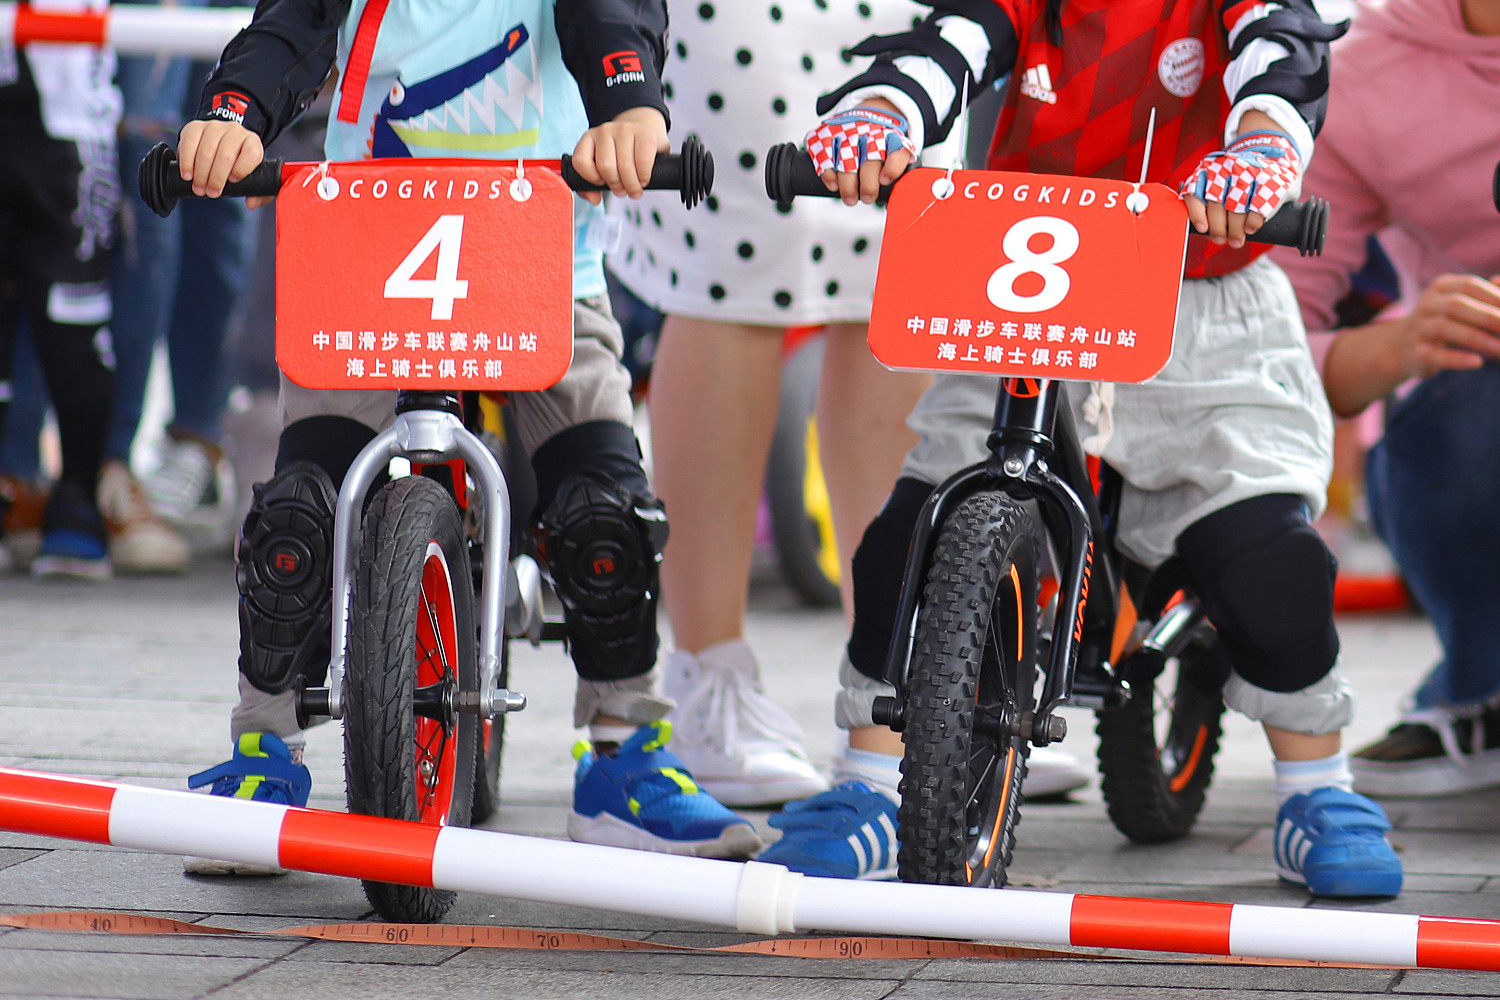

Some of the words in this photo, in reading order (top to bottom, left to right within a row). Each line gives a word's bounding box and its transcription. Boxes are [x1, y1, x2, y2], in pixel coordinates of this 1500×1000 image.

[349, 179, 502, 199] COGKIDS
[963, 181, 1119, 208] COGKIDS
[383, 214, 469, 321] 4
[985, 215, 1080, 313] 8
[312, 330, 538, 353] 中国滑步车联赛舟山站
[906, 315, 1138, 348] 中国滑步车联赛舟山站
[346, 358, 503, 379] 海上骑士俱乐部
[936, 342, 1099, 370] 海上骑士俱乐部
[90, 919, 111, 931] 40
[386, 929, 409, 942] 60
[537, 935, 560, 948] 70
[839, 939, 862, 956] 90
